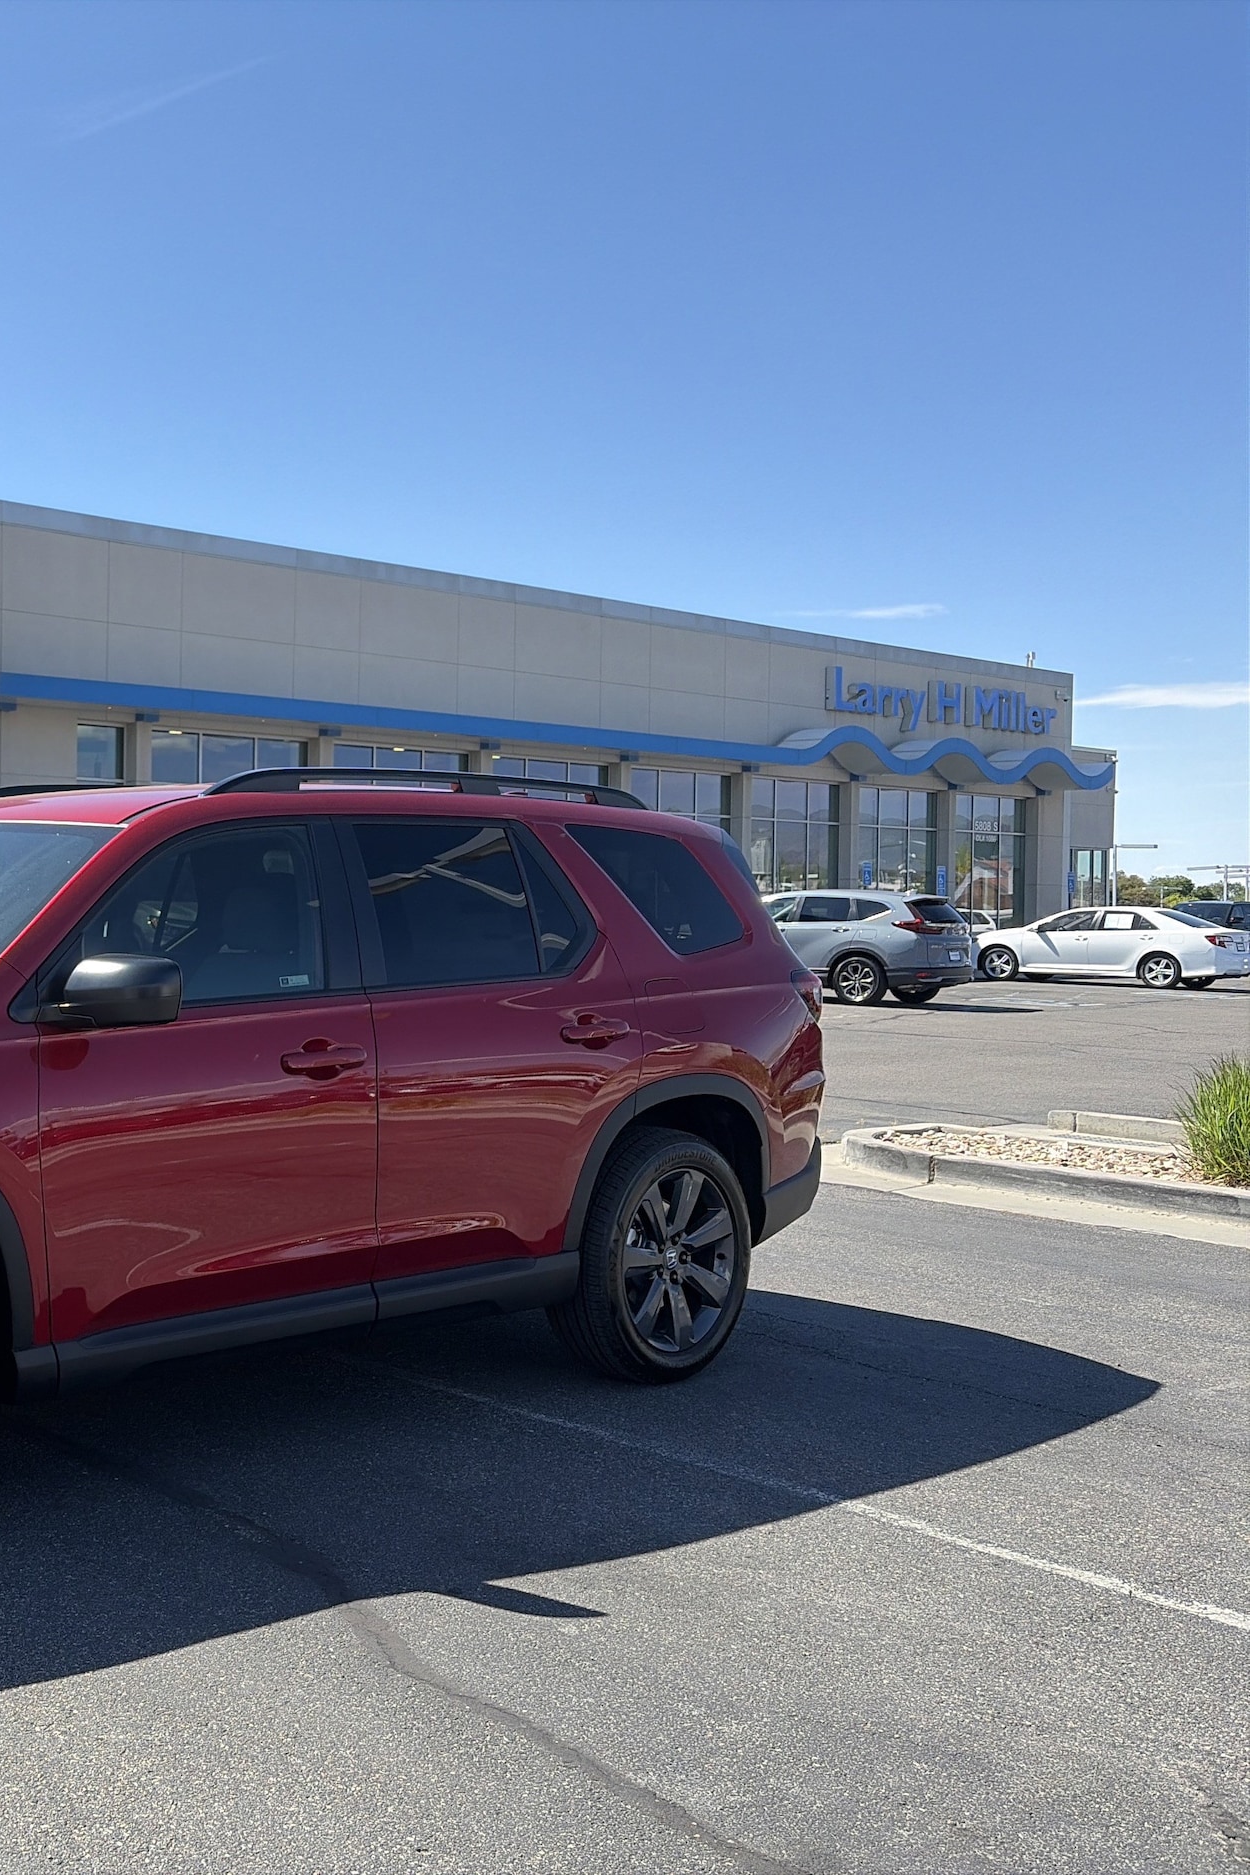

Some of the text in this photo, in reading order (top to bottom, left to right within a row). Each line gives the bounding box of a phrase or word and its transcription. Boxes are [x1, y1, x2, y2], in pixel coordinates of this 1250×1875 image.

[827, 666, 1057, 735] Larry H Miller
